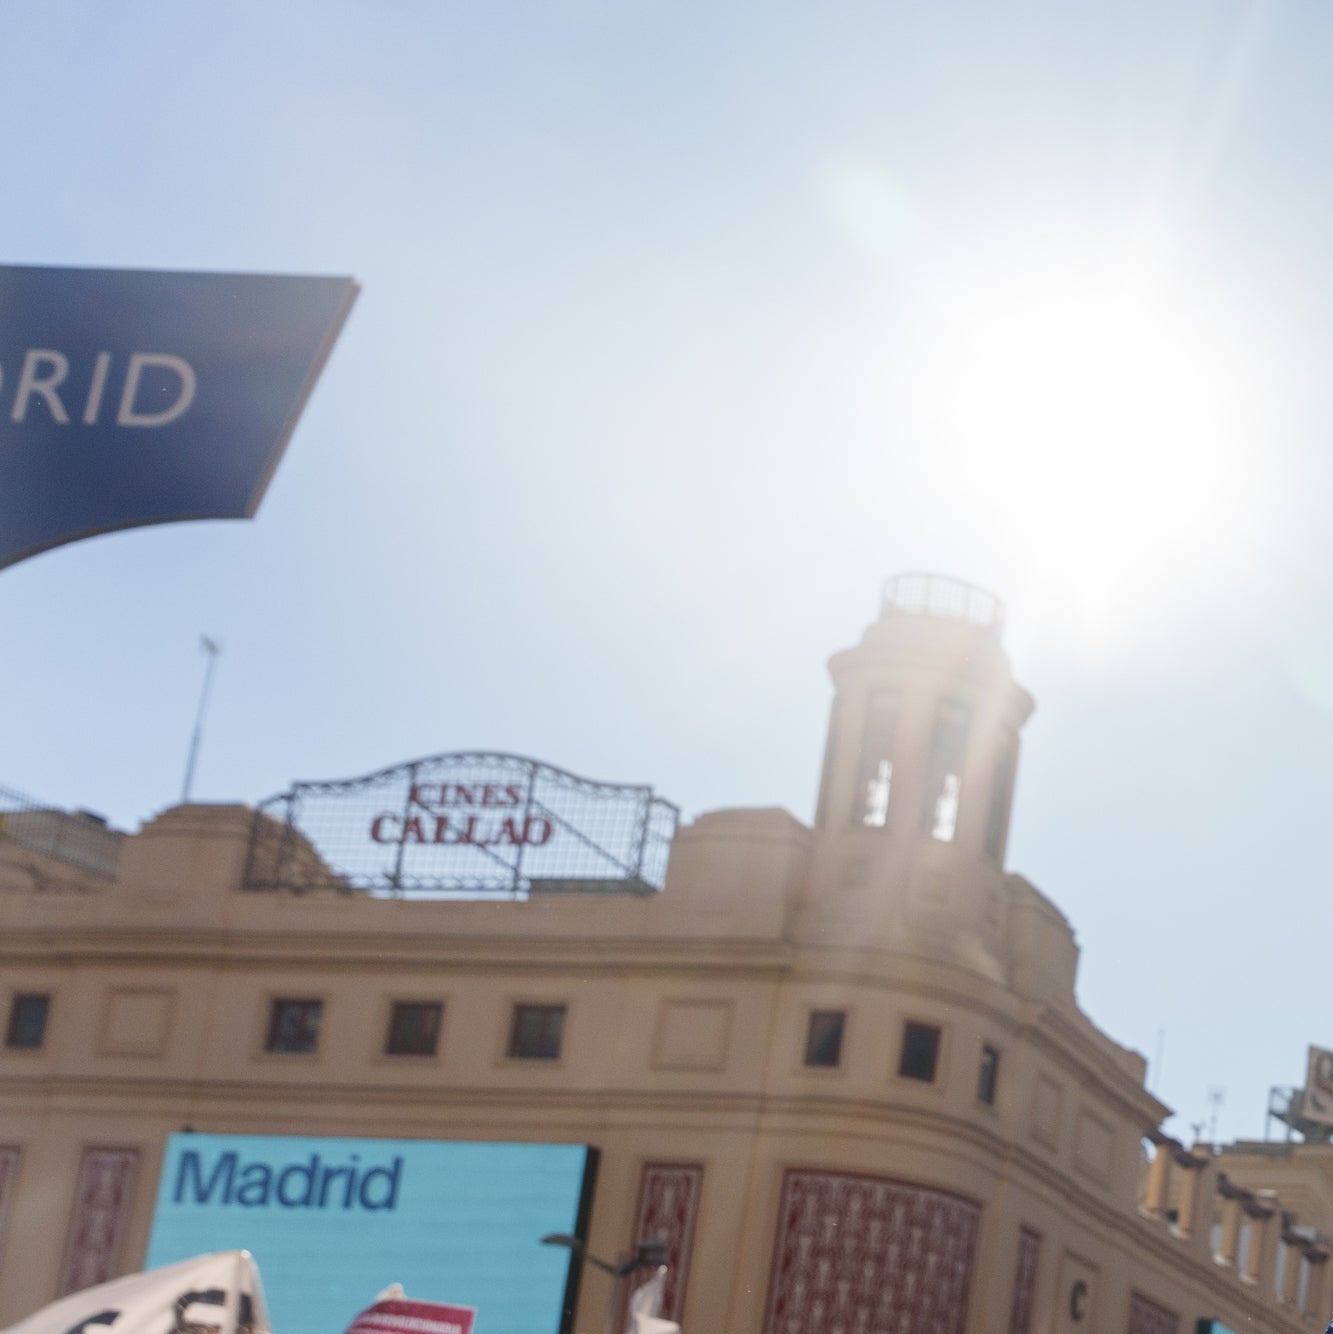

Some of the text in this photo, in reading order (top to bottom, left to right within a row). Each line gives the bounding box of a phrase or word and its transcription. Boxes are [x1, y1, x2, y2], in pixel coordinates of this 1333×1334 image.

[0, 348, 197, 427] RID
[408, 782, 523, 808] CINES
[370, 812, 554, 845] CALLAO
[173, 1150, 404, 1211] Madrid
